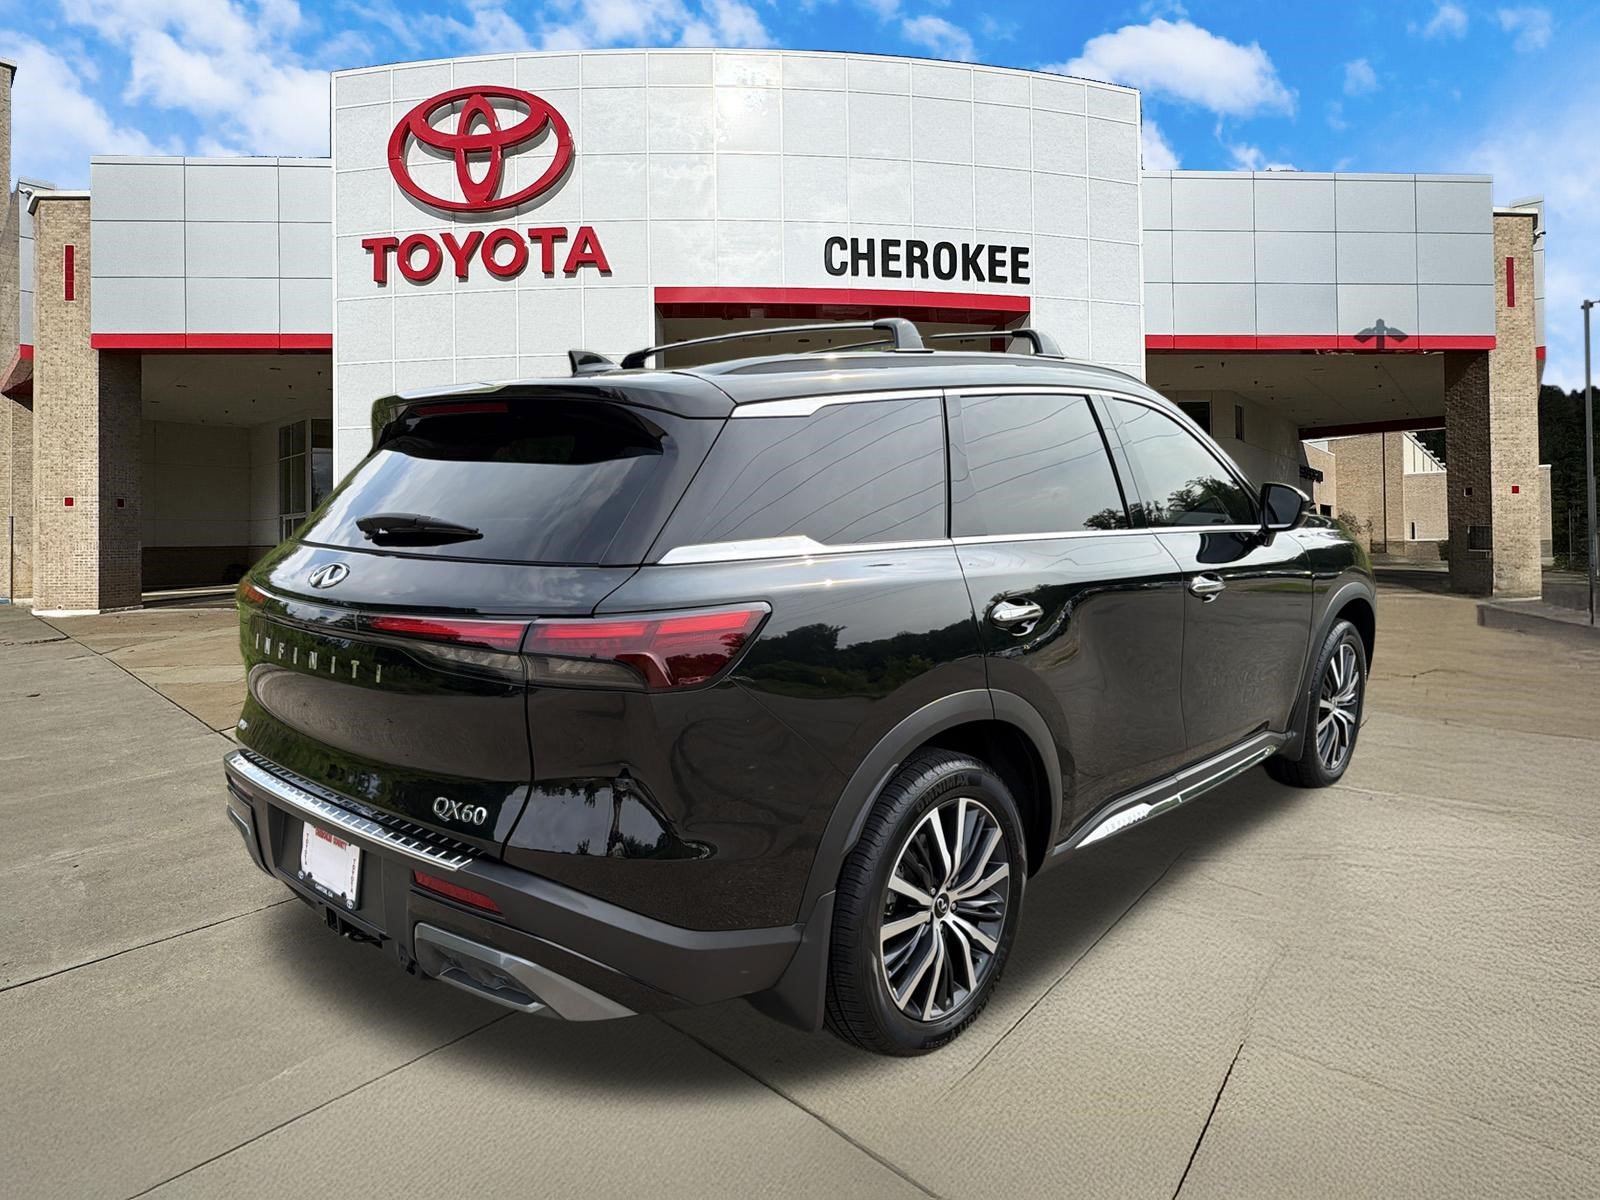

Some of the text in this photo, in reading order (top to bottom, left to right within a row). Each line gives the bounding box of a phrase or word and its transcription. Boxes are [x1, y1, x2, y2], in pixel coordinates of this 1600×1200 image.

[362, 226, 612, 286] TOYOTA
[824, 236, 1031, 285] CHEROKEE
[255, 633, 382, 684] INFINITI
[433, 796, 488, 826] QX60
